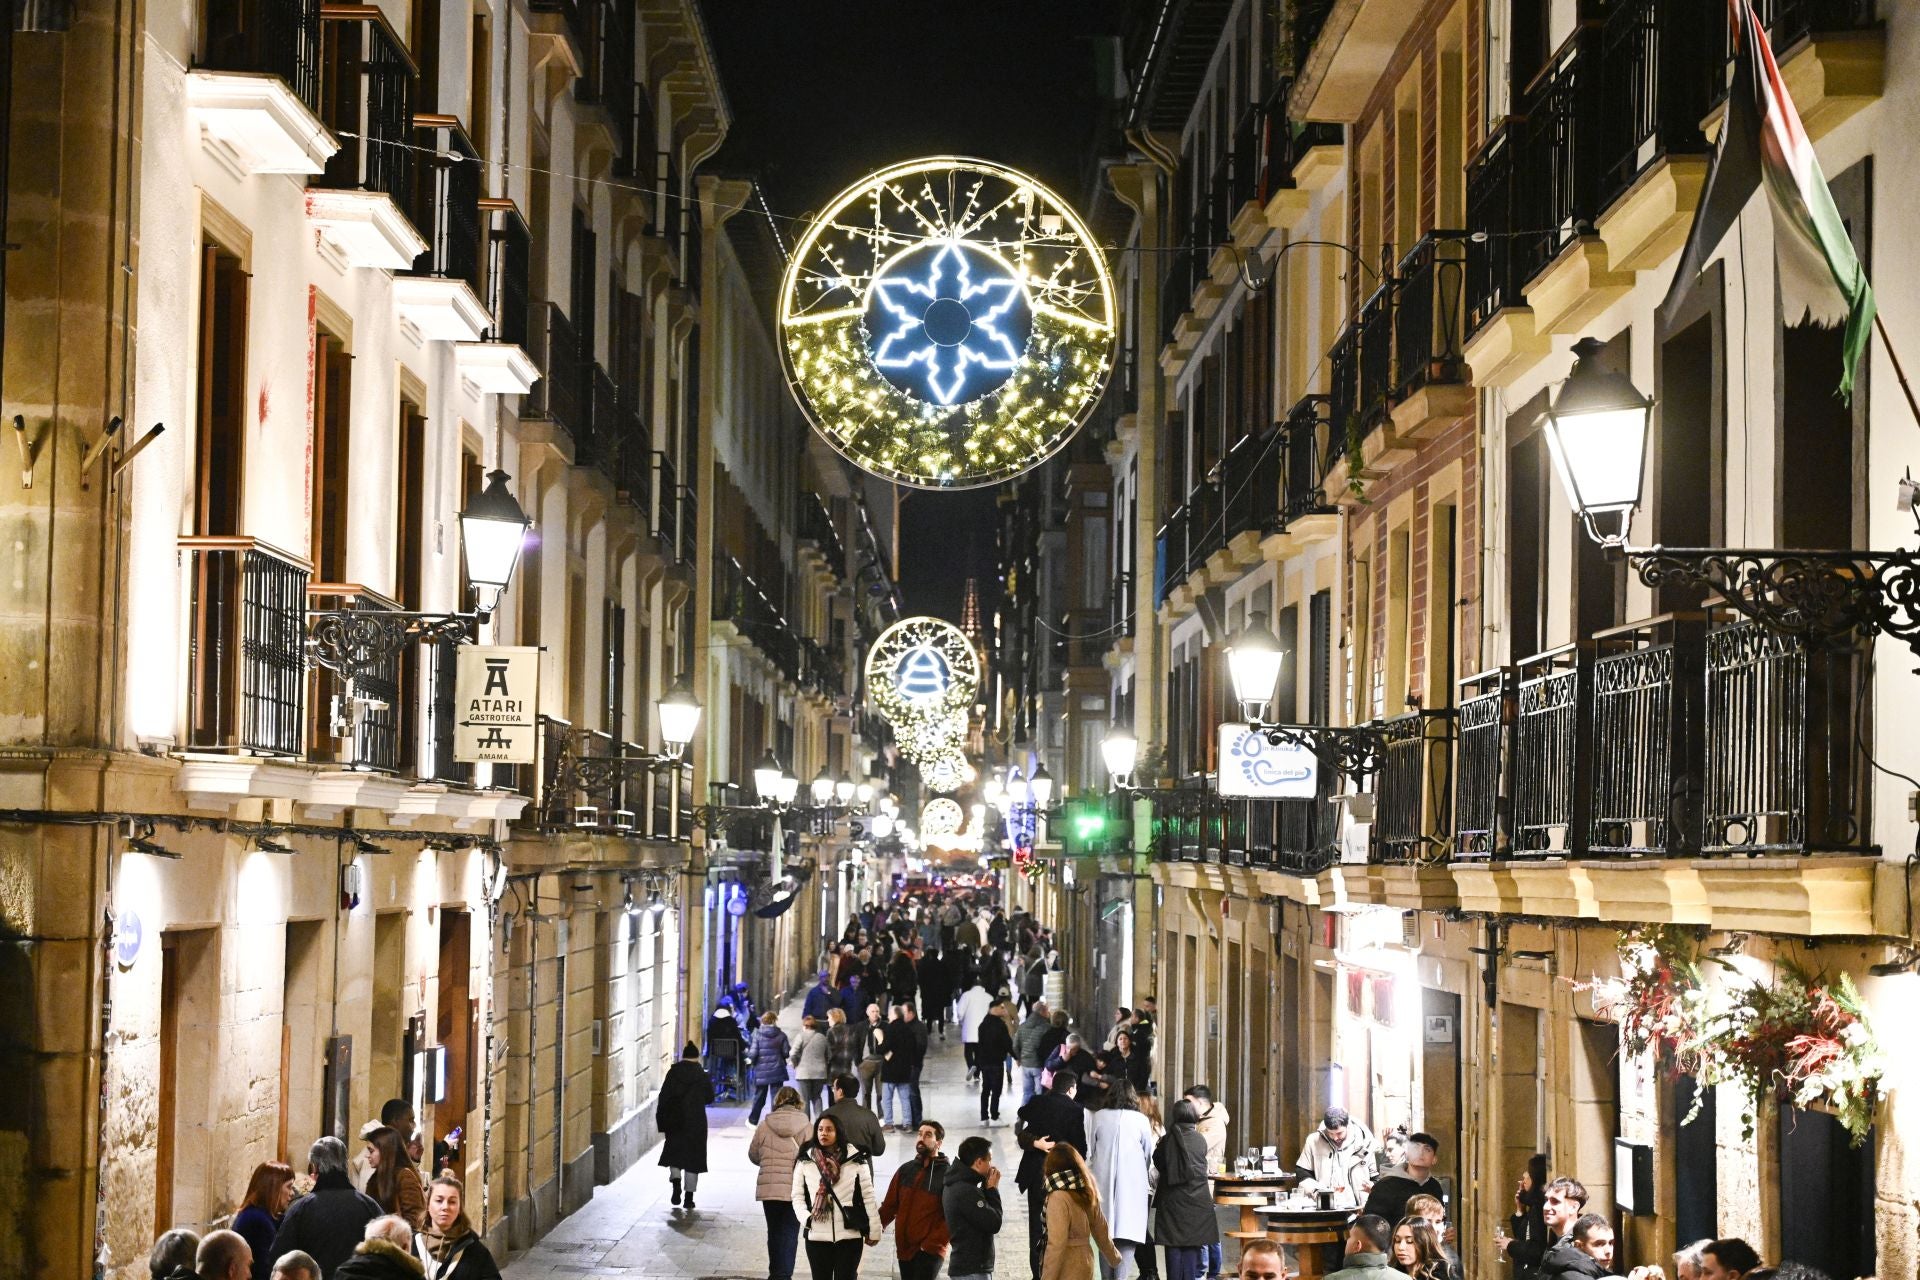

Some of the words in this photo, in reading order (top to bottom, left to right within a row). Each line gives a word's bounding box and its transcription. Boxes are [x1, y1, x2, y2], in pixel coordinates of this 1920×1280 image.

[470, 699, 523, 713] ATARI
[469, 713, 522, 722] GASTROTEKA
[1282, 768, 1294, 776] del
